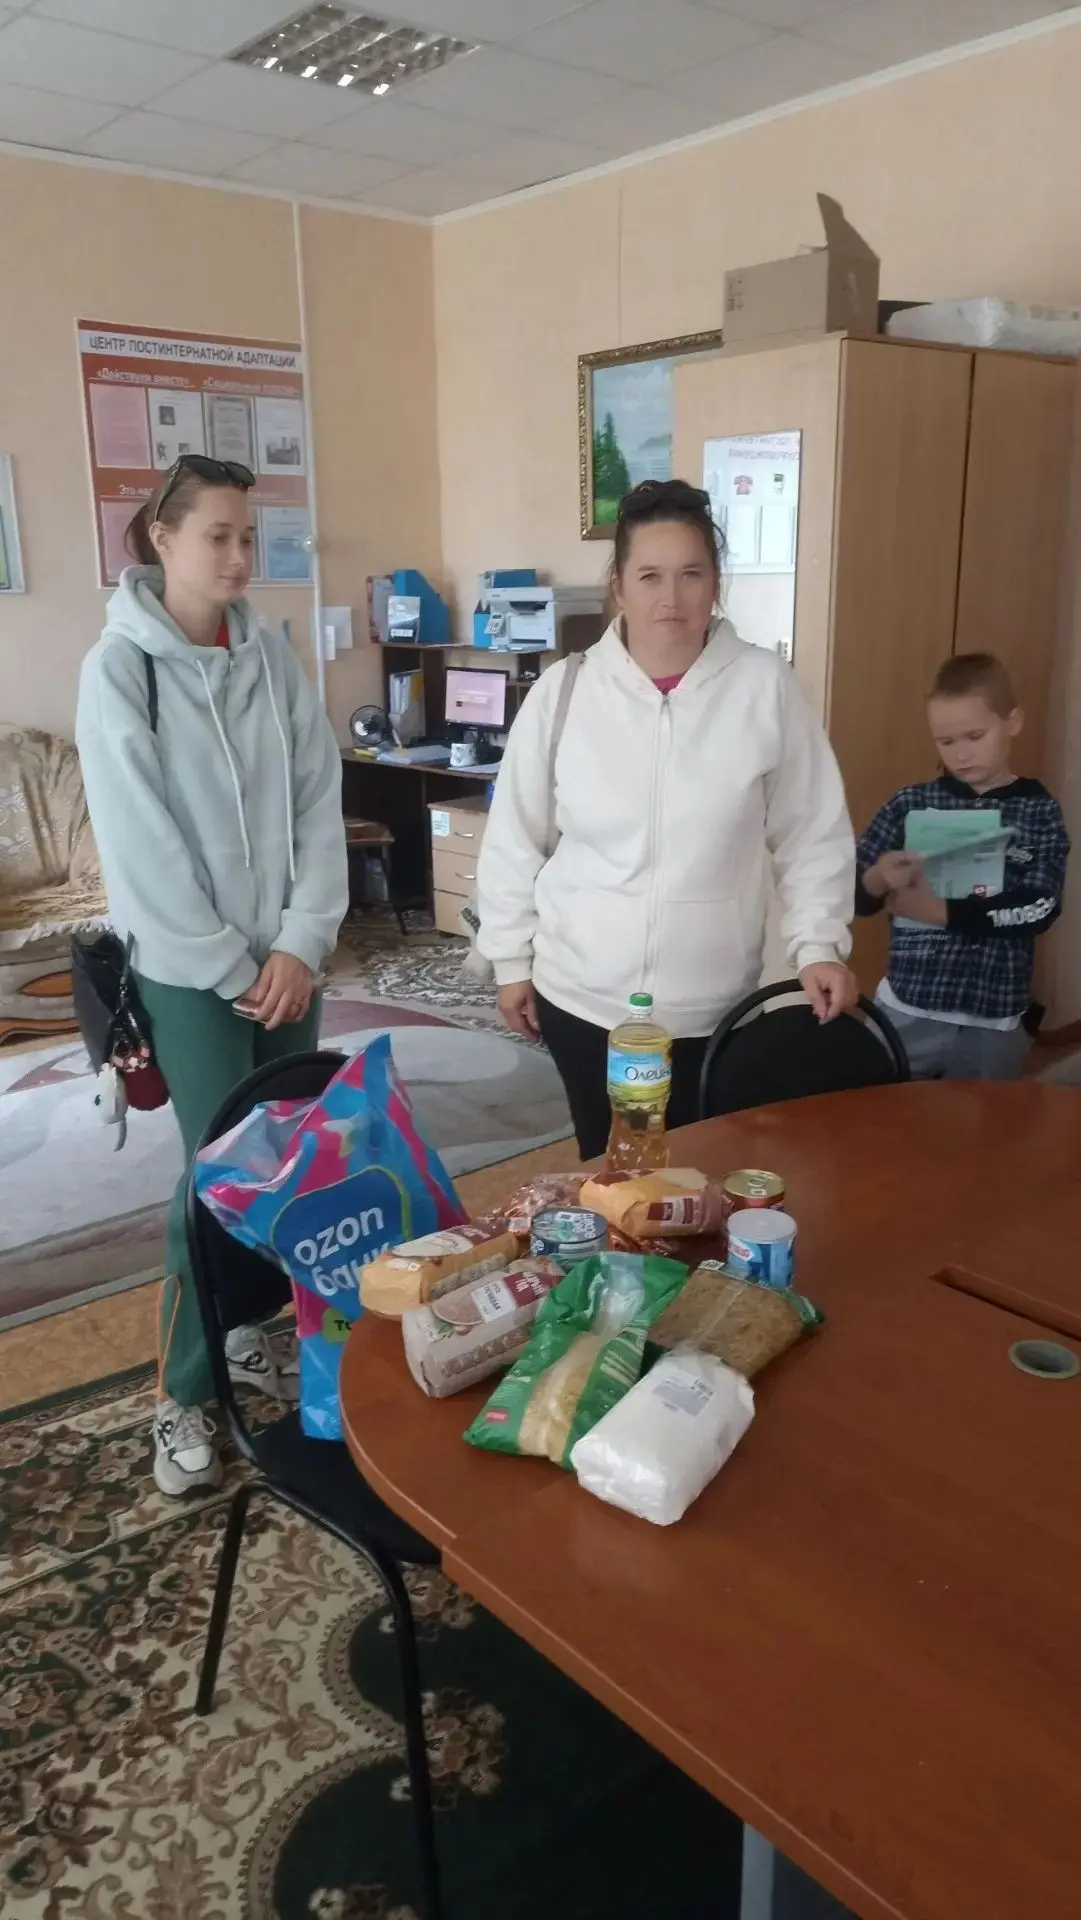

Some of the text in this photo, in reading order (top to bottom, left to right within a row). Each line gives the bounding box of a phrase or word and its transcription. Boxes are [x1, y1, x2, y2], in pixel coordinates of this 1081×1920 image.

[89, 335, 296, 368] ЦЕНТР ПОСТИНТЕРНАТНОЙ АДАПТАЦИИ
[119, 483, 136, 496] Это
[294, 1206, 384, 1266] ozon
[312, 1242, 393, 1297] бан
